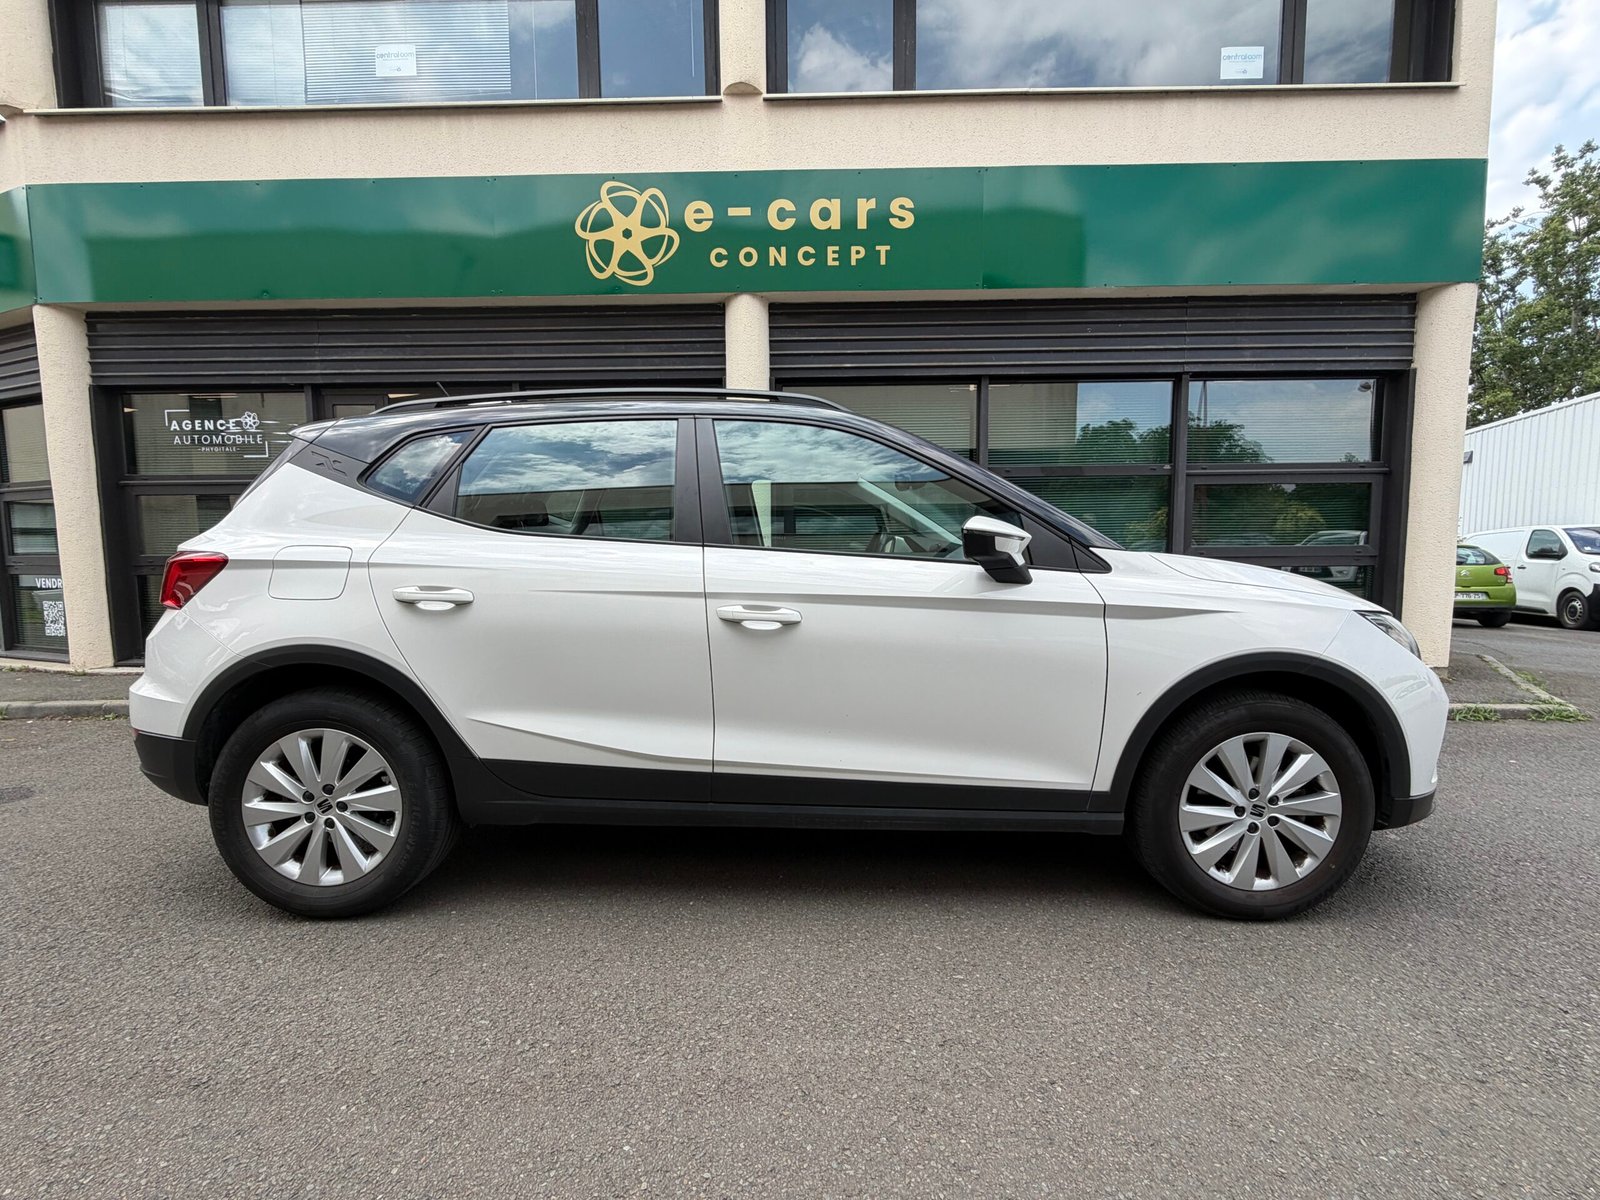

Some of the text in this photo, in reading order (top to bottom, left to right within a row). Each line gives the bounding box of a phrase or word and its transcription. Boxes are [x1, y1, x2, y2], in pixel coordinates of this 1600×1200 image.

[709, 245, 891, 268] CONCEPT
[170, 419, 237, 431] AGENCE
[173, 434, 263, 445] AUTOMOBILE
